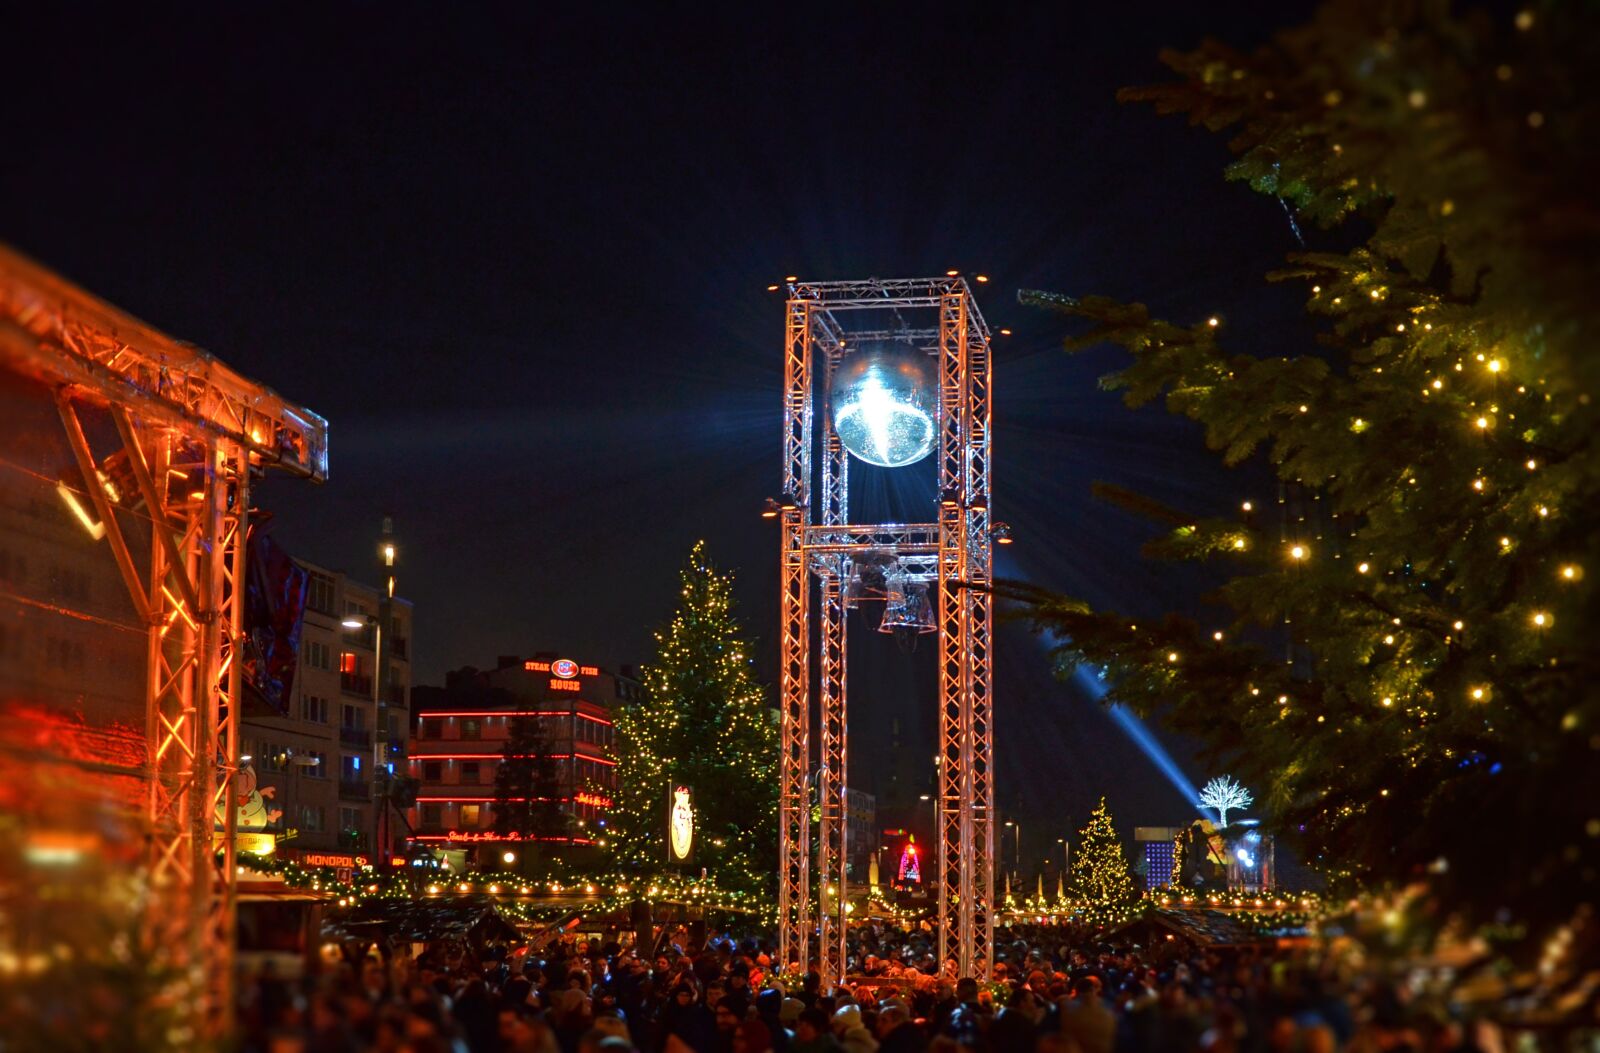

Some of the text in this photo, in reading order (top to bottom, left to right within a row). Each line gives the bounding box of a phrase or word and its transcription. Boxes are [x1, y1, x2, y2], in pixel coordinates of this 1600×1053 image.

[525, 661, 550, 672] STEAK
[580, 666, 598, 676] FISH
[550, 679, 580, 691] HOUSE
[306, 855, 354, 867] MONOPOL
